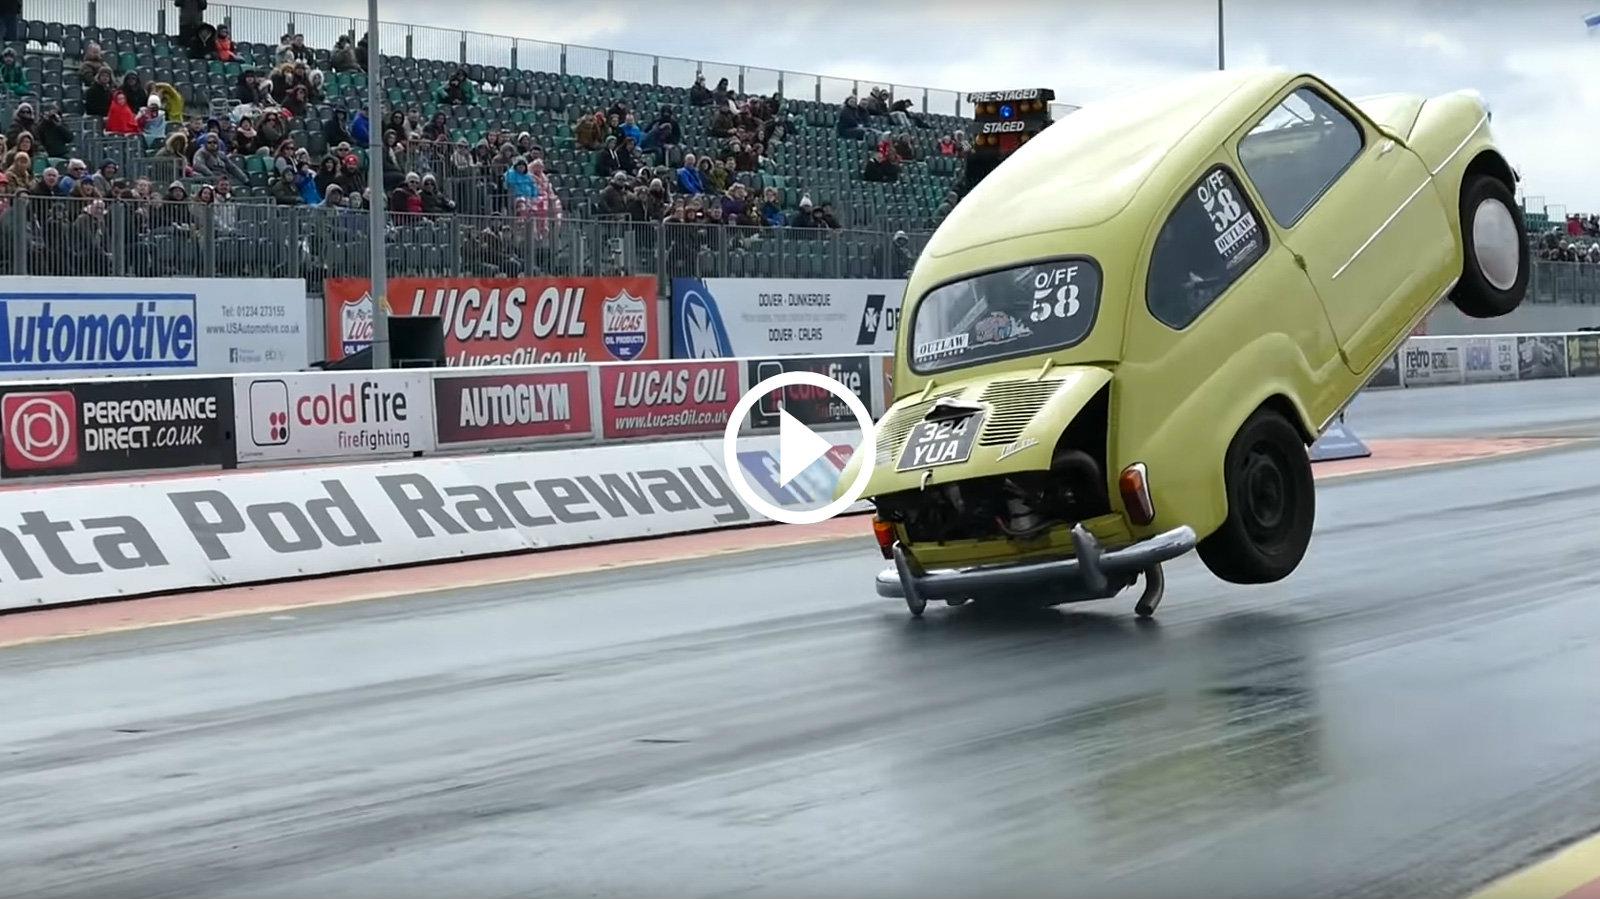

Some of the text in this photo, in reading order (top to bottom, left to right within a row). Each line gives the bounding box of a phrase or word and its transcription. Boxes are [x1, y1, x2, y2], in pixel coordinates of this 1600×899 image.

[970, 90, 1038, 101] PRE-STAGED
[983, 121, 1025, 133] STAGED
[1203, 188, 1241, 232] 58
[1035, 267, 1078, 289] O/FF
[759, 294, 782, 306] DOVER
[788, 294, 831, 306] DUNKERQUE
[1030, 285, 1080, 322] 58
[533, 287, 586, 337] OIL
[608, 315, 643, 331] LUCAS
[348, 321, 373, 339] LUC
[769, 329, 793, 341] DOVER
[798, 328, 822, 340] CALAIS
[614, 368, 727, 407] LUCAS OIL
[83, 397, 217, 425] PERFORMANCE
[460, 383, 570, 427] AUTOGLYM
[615, 409, 729, 430] www.LucasOil.co.uk
[919, 418, 967, 443] 324
[338, 430, 410, 450] firefighting
[913, 440, 959, 465] YUA
[167, 479, 382, 560] Pod
[375, 465, 750, 538] Raceway
